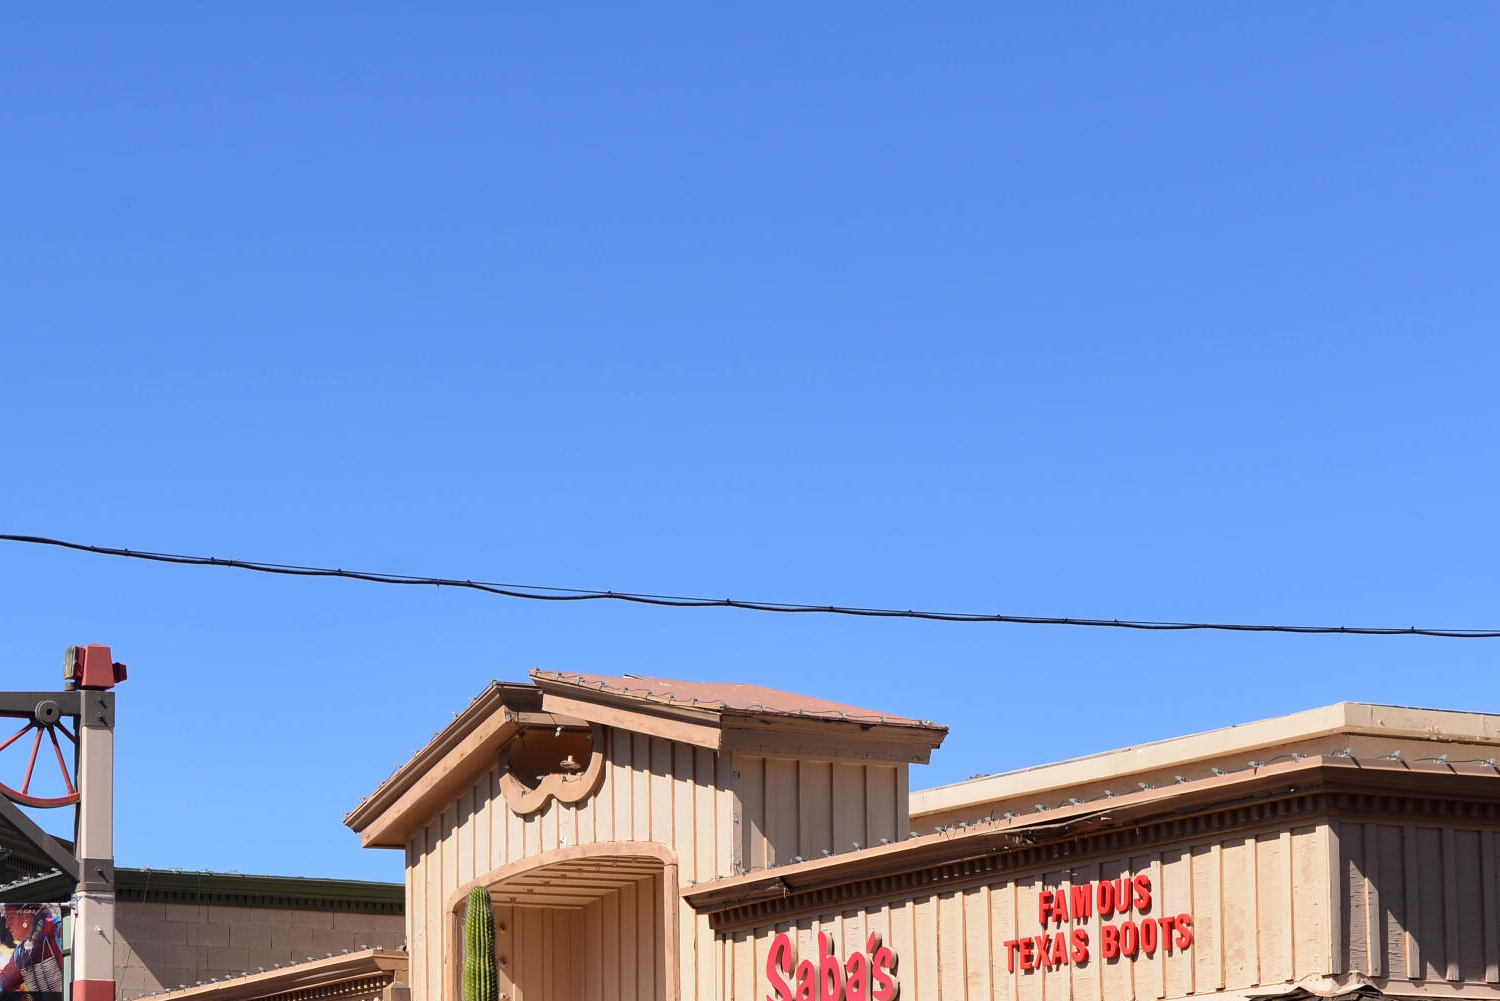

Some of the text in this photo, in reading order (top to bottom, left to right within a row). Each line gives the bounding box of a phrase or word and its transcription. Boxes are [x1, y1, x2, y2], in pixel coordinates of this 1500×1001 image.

[1039, 874, 1152, 925] FAMOUS
[1003, 913, 1193, 973] TEXAS BOOTS
